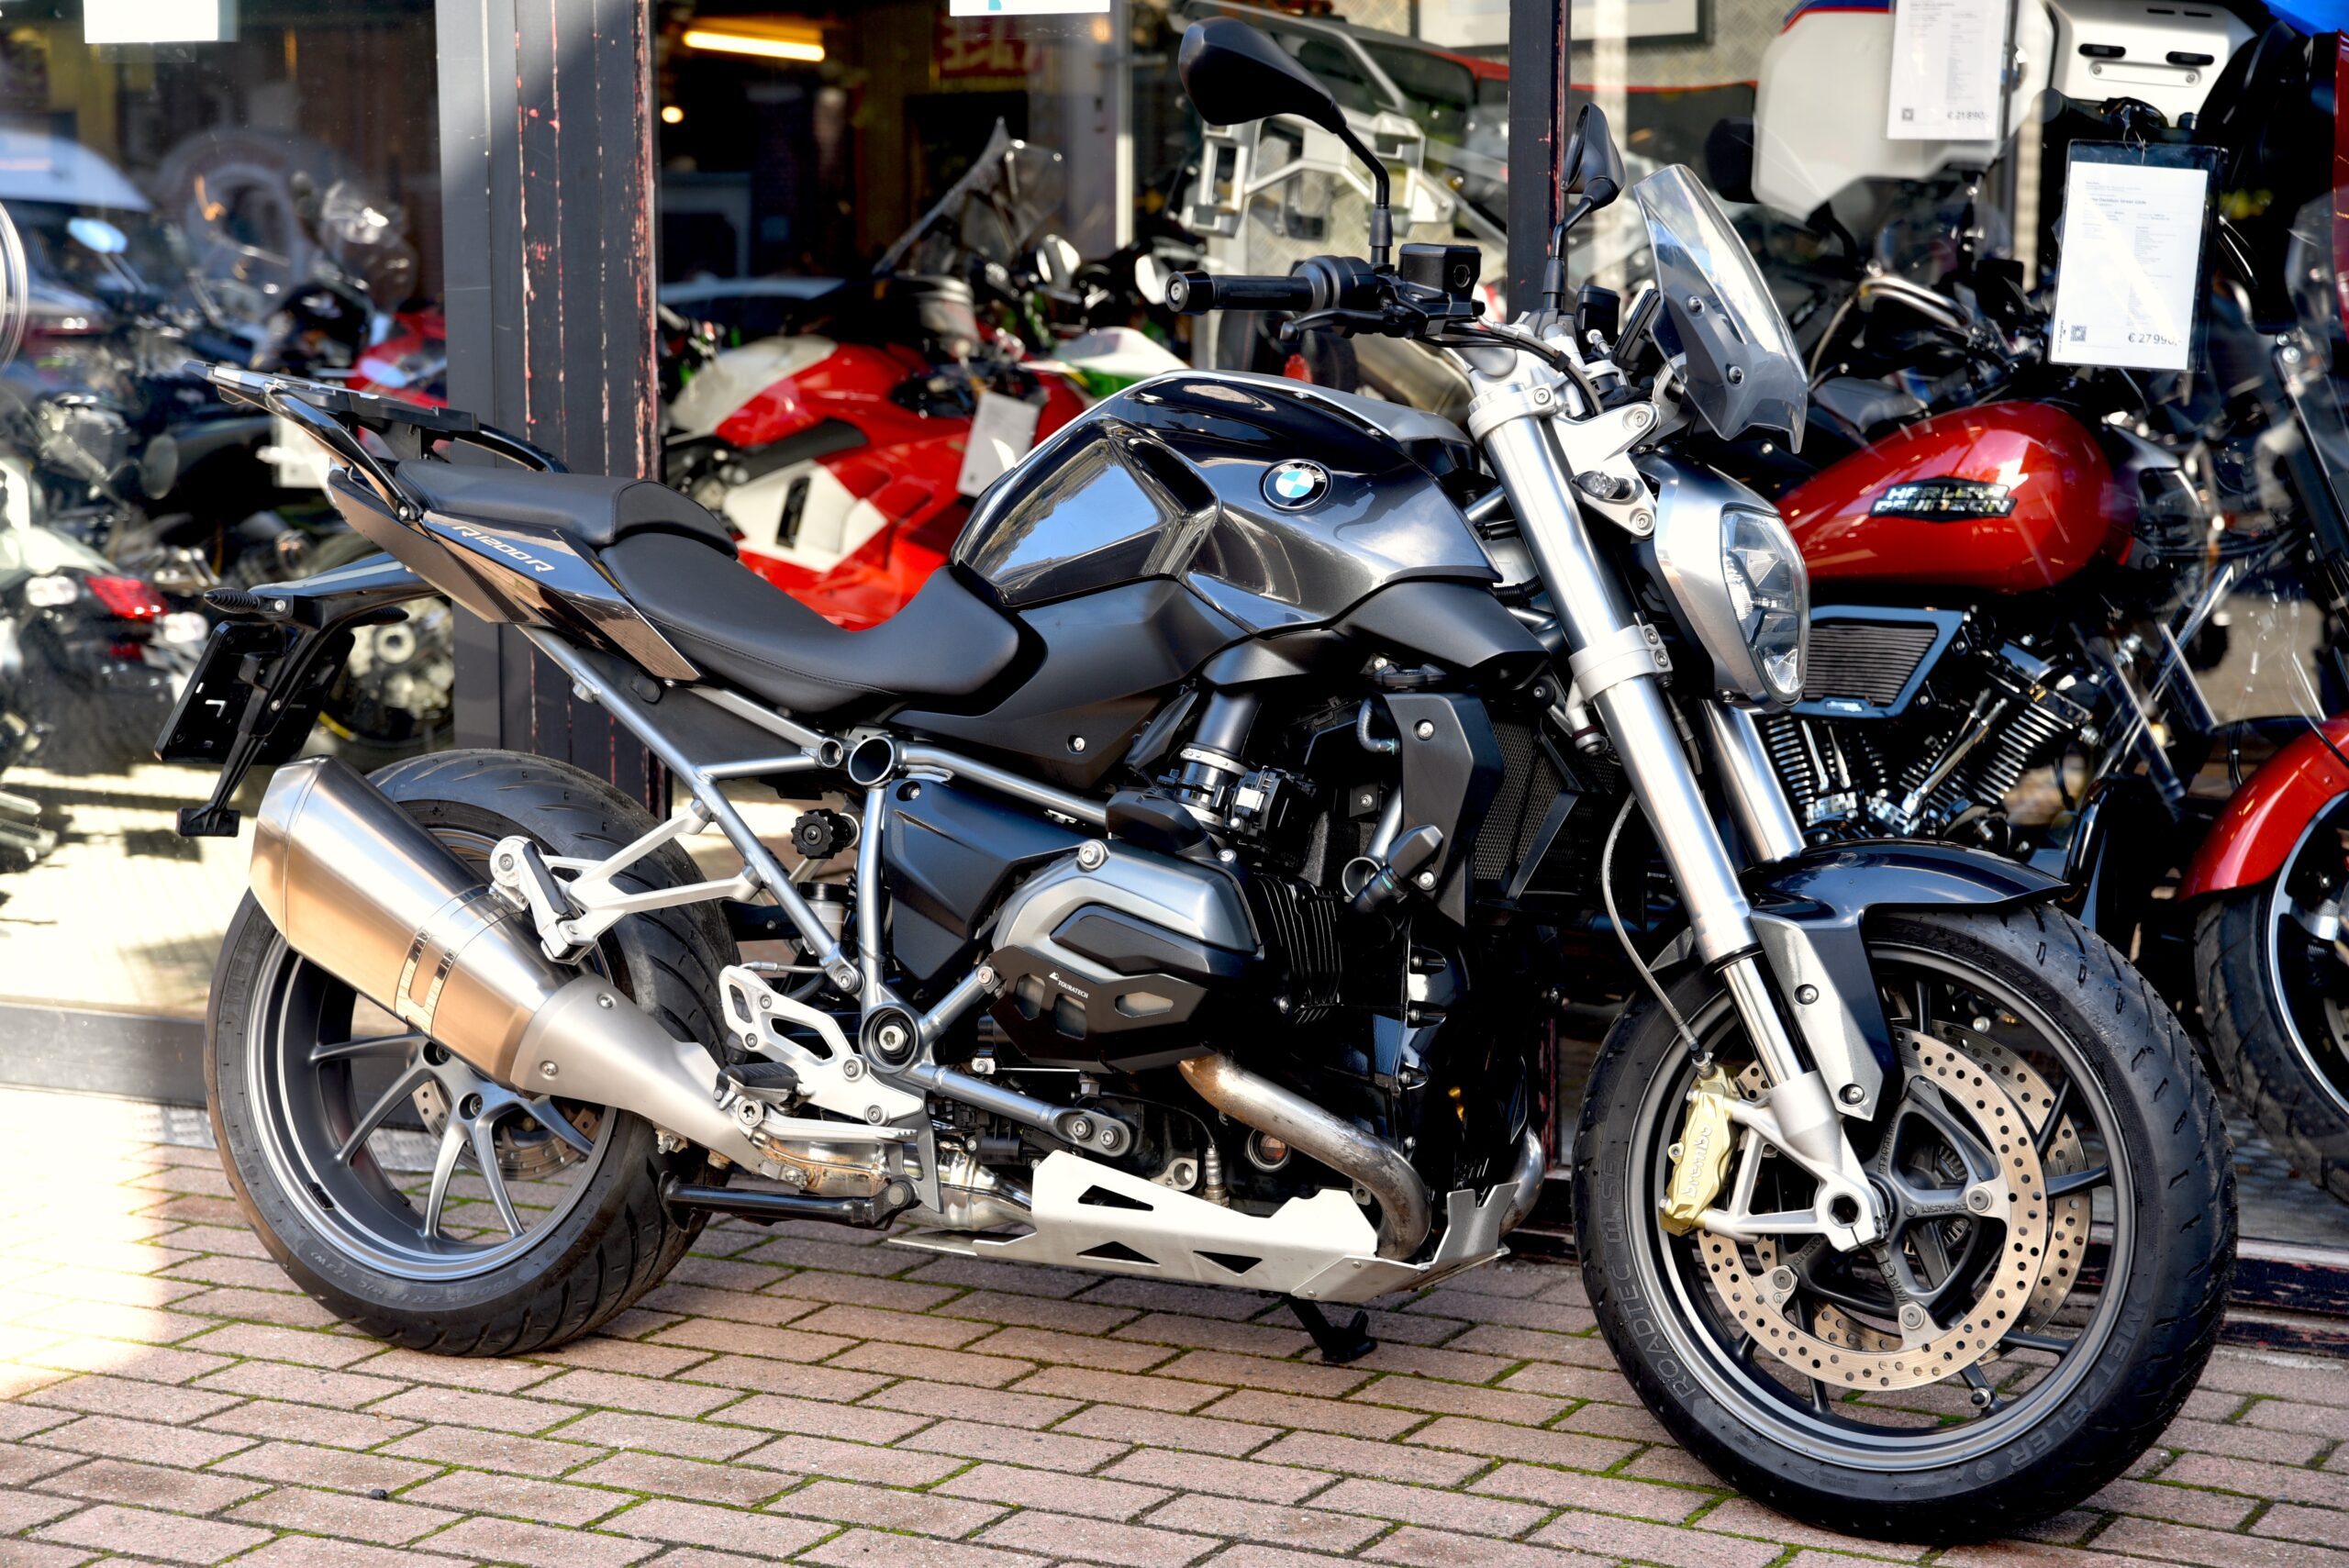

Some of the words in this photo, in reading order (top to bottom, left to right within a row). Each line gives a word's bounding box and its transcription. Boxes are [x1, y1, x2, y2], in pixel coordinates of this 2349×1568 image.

[452, 526, 555, 573] R1200R
[1057, 979, 1089, 999] TOURATECH
[1682, 1123, 1713, 1198] brembo
[1609, 1262, 1697, 1399] ROADTEC
[2005, 1307, 2147, 1467] METZELER
